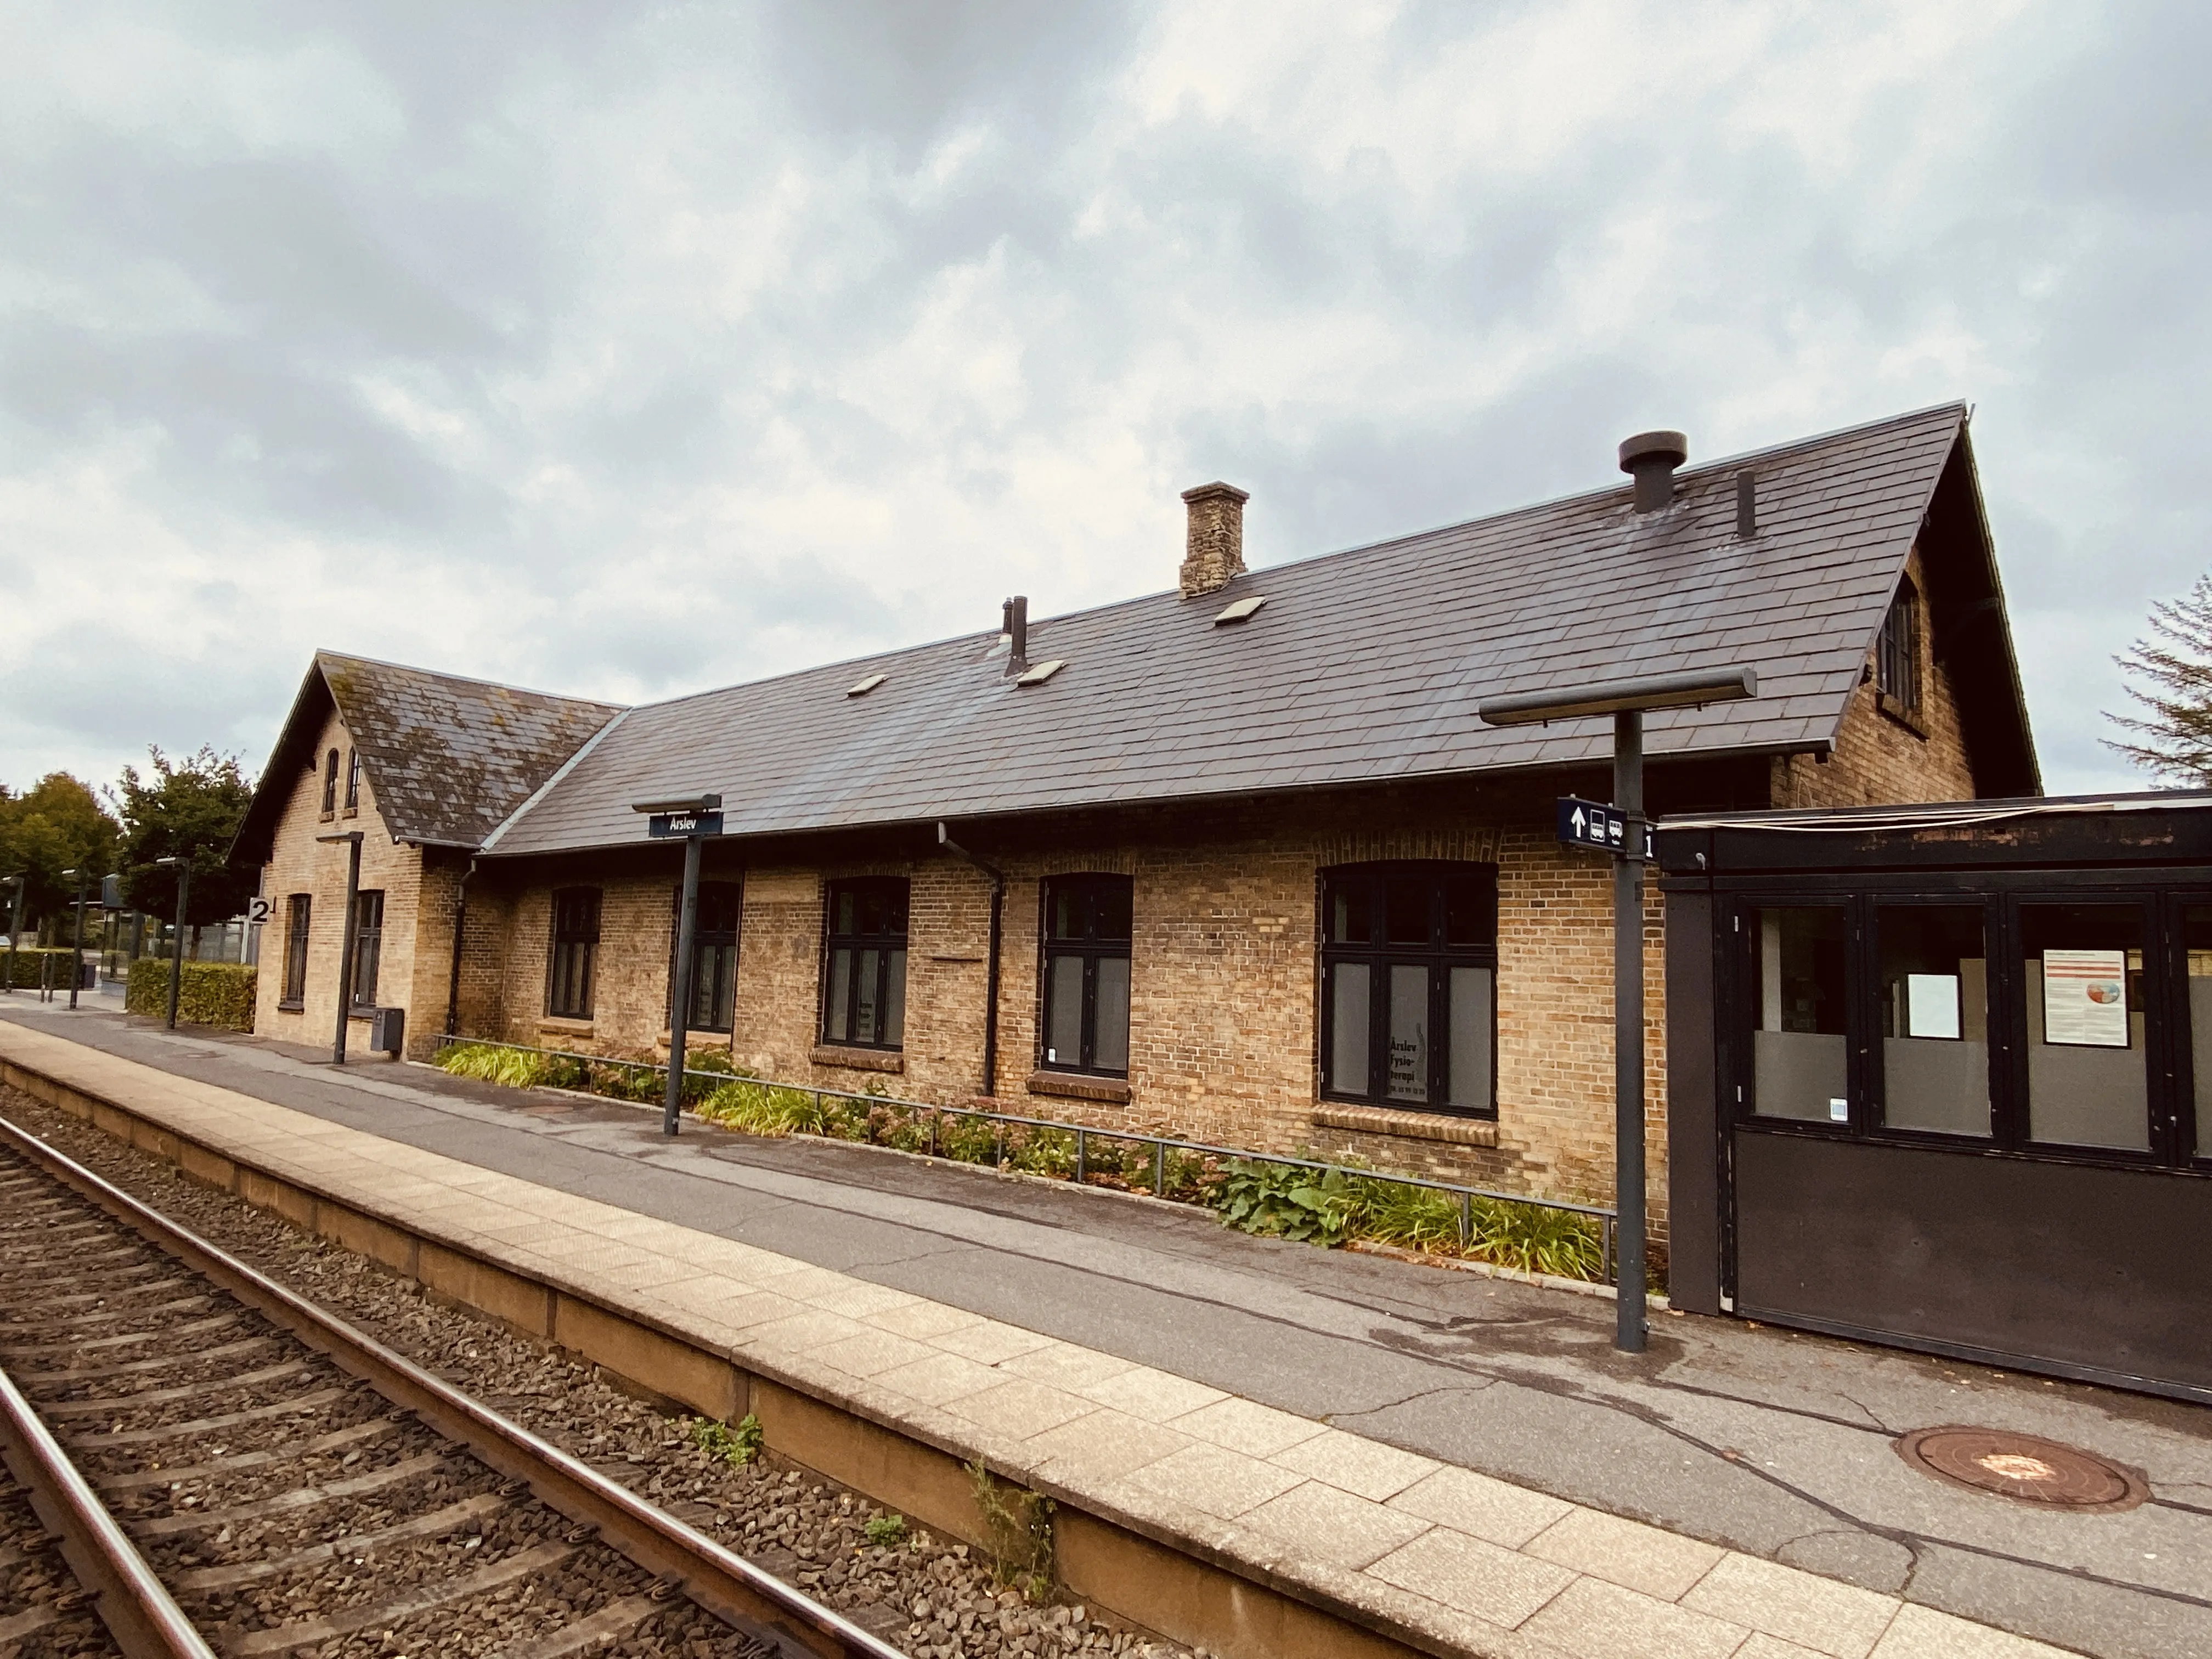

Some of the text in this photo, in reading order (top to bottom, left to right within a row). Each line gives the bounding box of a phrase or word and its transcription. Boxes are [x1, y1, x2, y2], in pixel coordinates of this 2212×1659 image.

[252, 901, 269, 922] 2
[1390, 1036, 1417, 1052] Årslev
[1390, 1053, 1415, 1068] Fysio-
[1390, 1070, 1414, 1084] terapi
